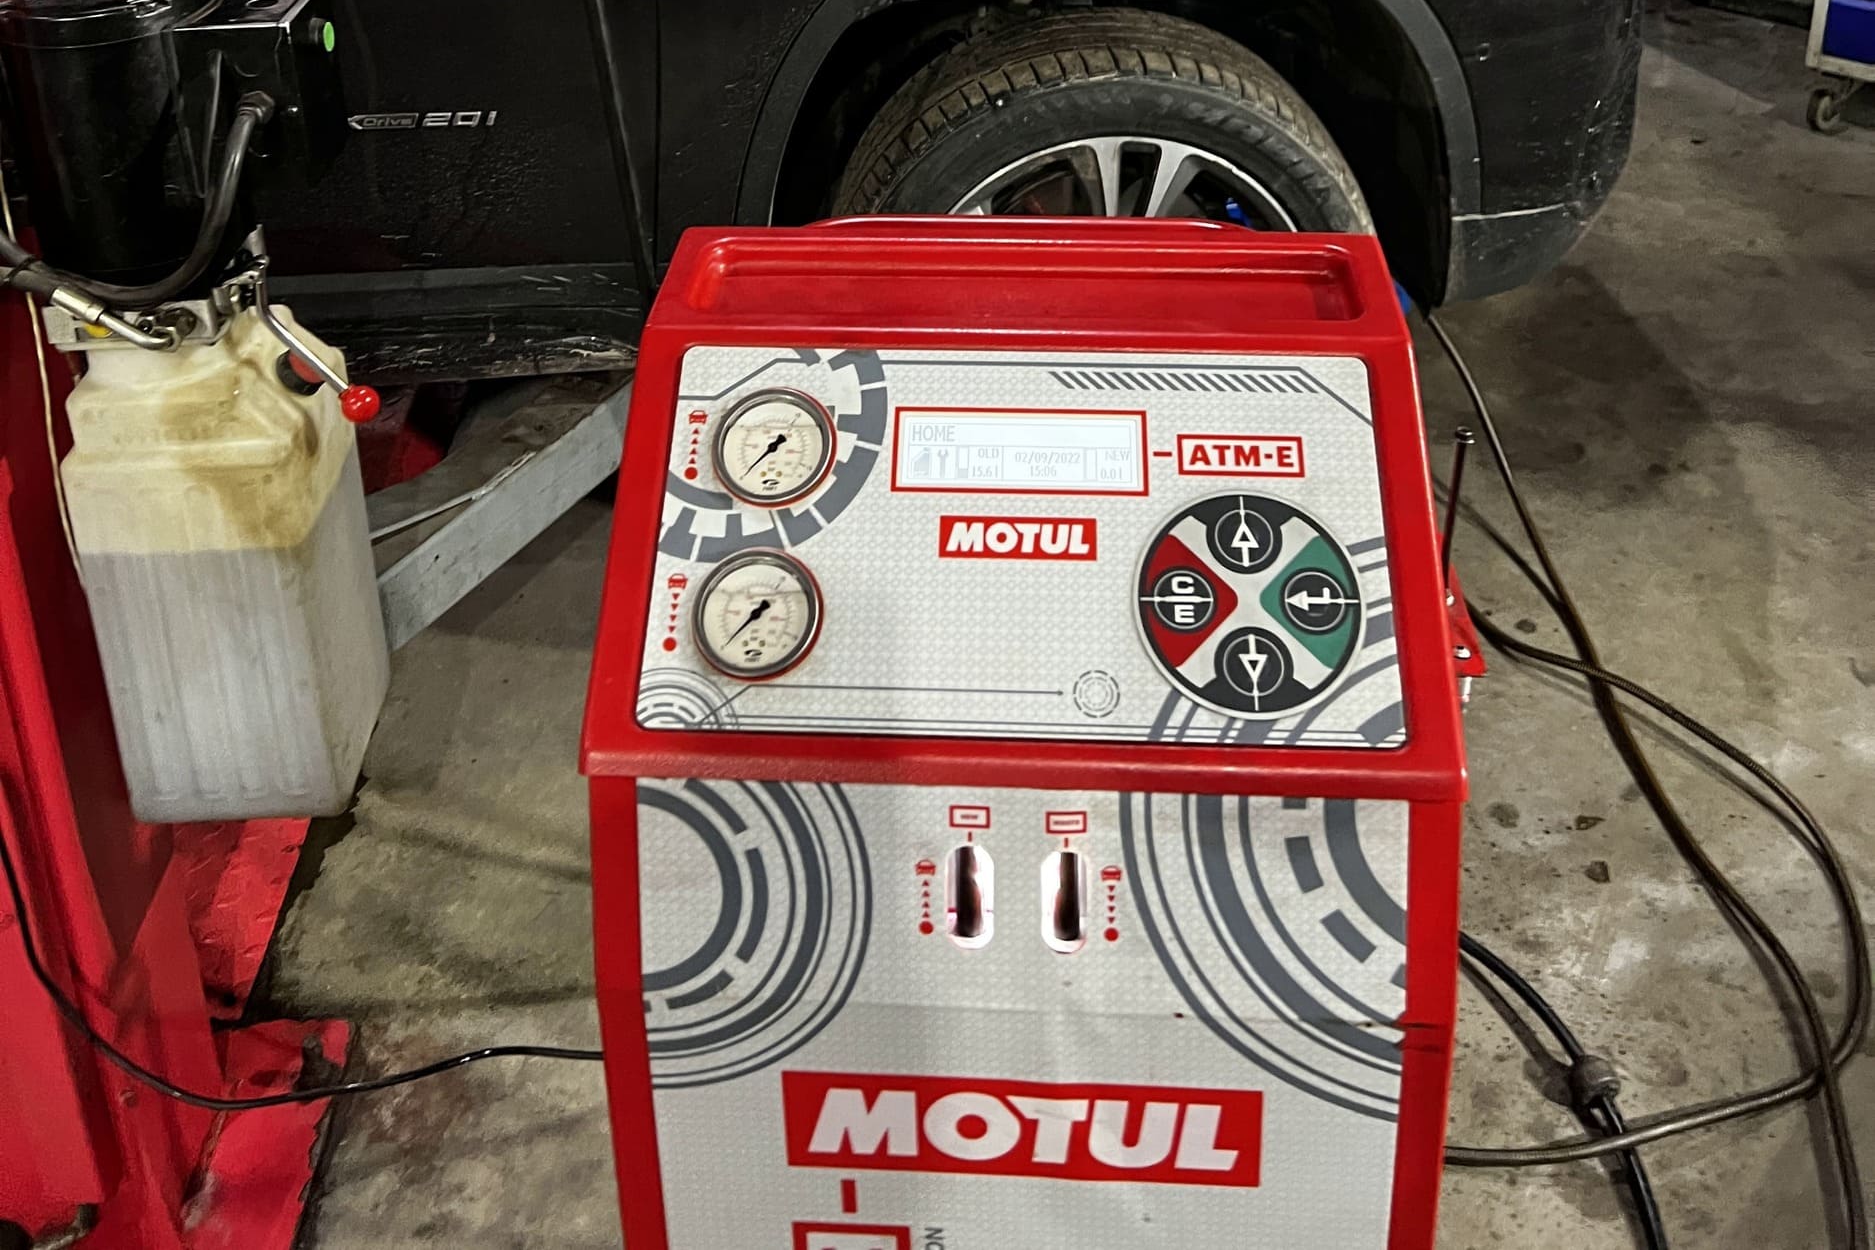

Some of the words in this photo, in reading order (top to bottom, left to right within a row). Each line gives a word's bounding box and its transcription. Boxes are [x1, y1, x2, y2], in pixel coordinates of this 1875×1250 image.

[912, 425, 955, 442] HOME
[978, 448, 999, 459] OLD
[1014, 452, 1081, 464] 02/09/2022
[1105, 450, 1130, 462] NEW
[1189, 444, 1294, 468] ATM-E
[1029, 465, 1057, 478] 15:06
[945, 522, 1090, 555] MOTUL
[1171, 576, 1195, 594] C
[1174, 604, 1195, 623] E
[808, 1088, 1238, 1171] MOTUL
